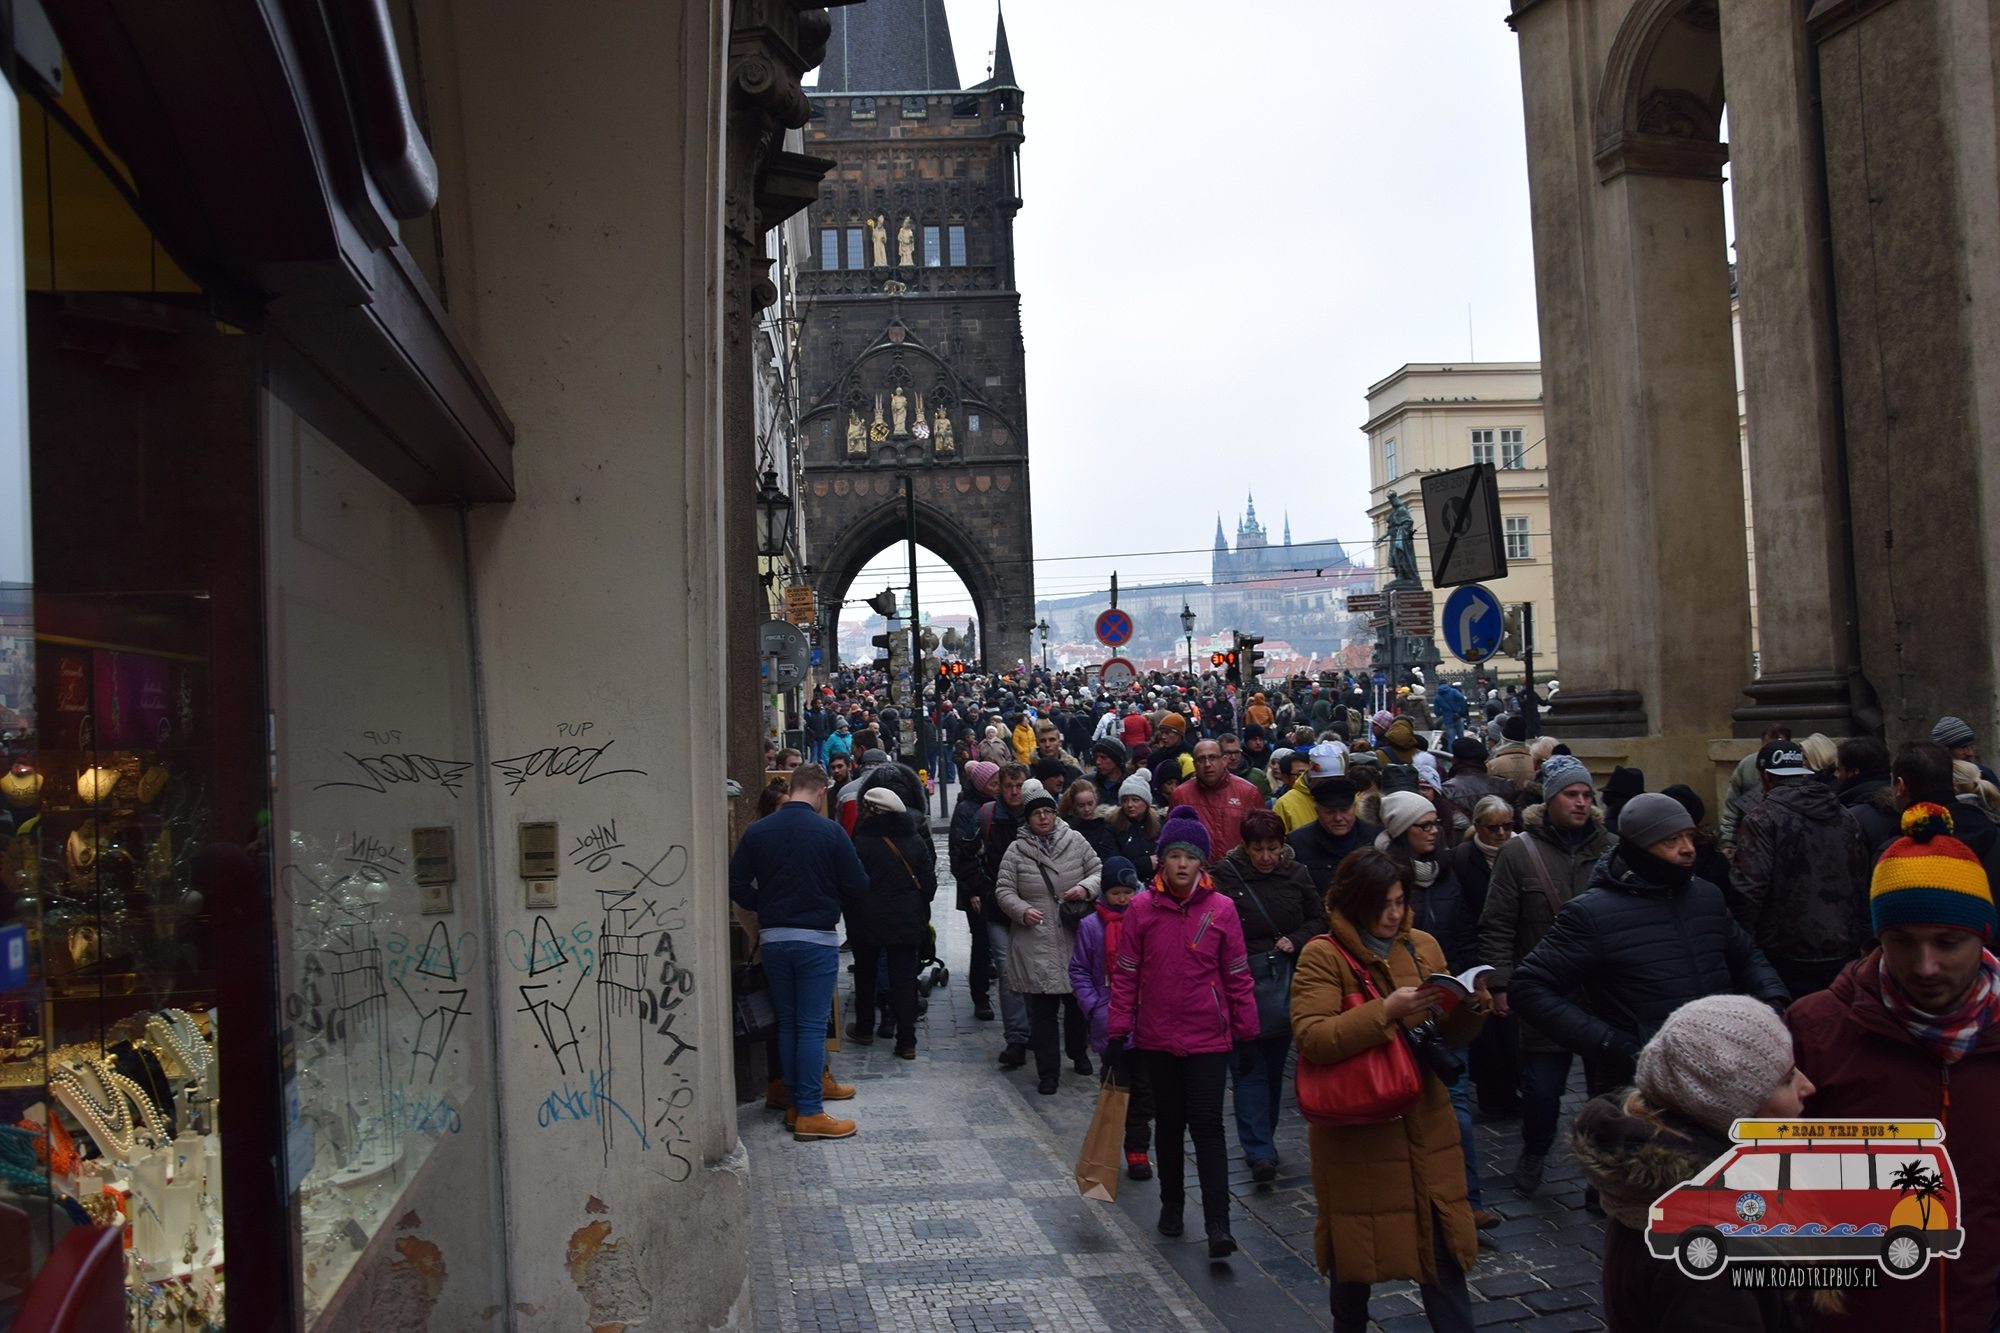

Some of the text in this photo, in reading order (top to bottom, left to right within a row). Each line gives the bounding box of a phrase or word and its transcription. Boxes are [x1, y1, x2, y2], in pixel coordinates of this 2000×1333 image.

[1213, 655, 1223, 664] 31
[952, 663, 964, 673] 31
[557, 722, 594, 737] PUP
[569, 818, 618, 855] JOHN
